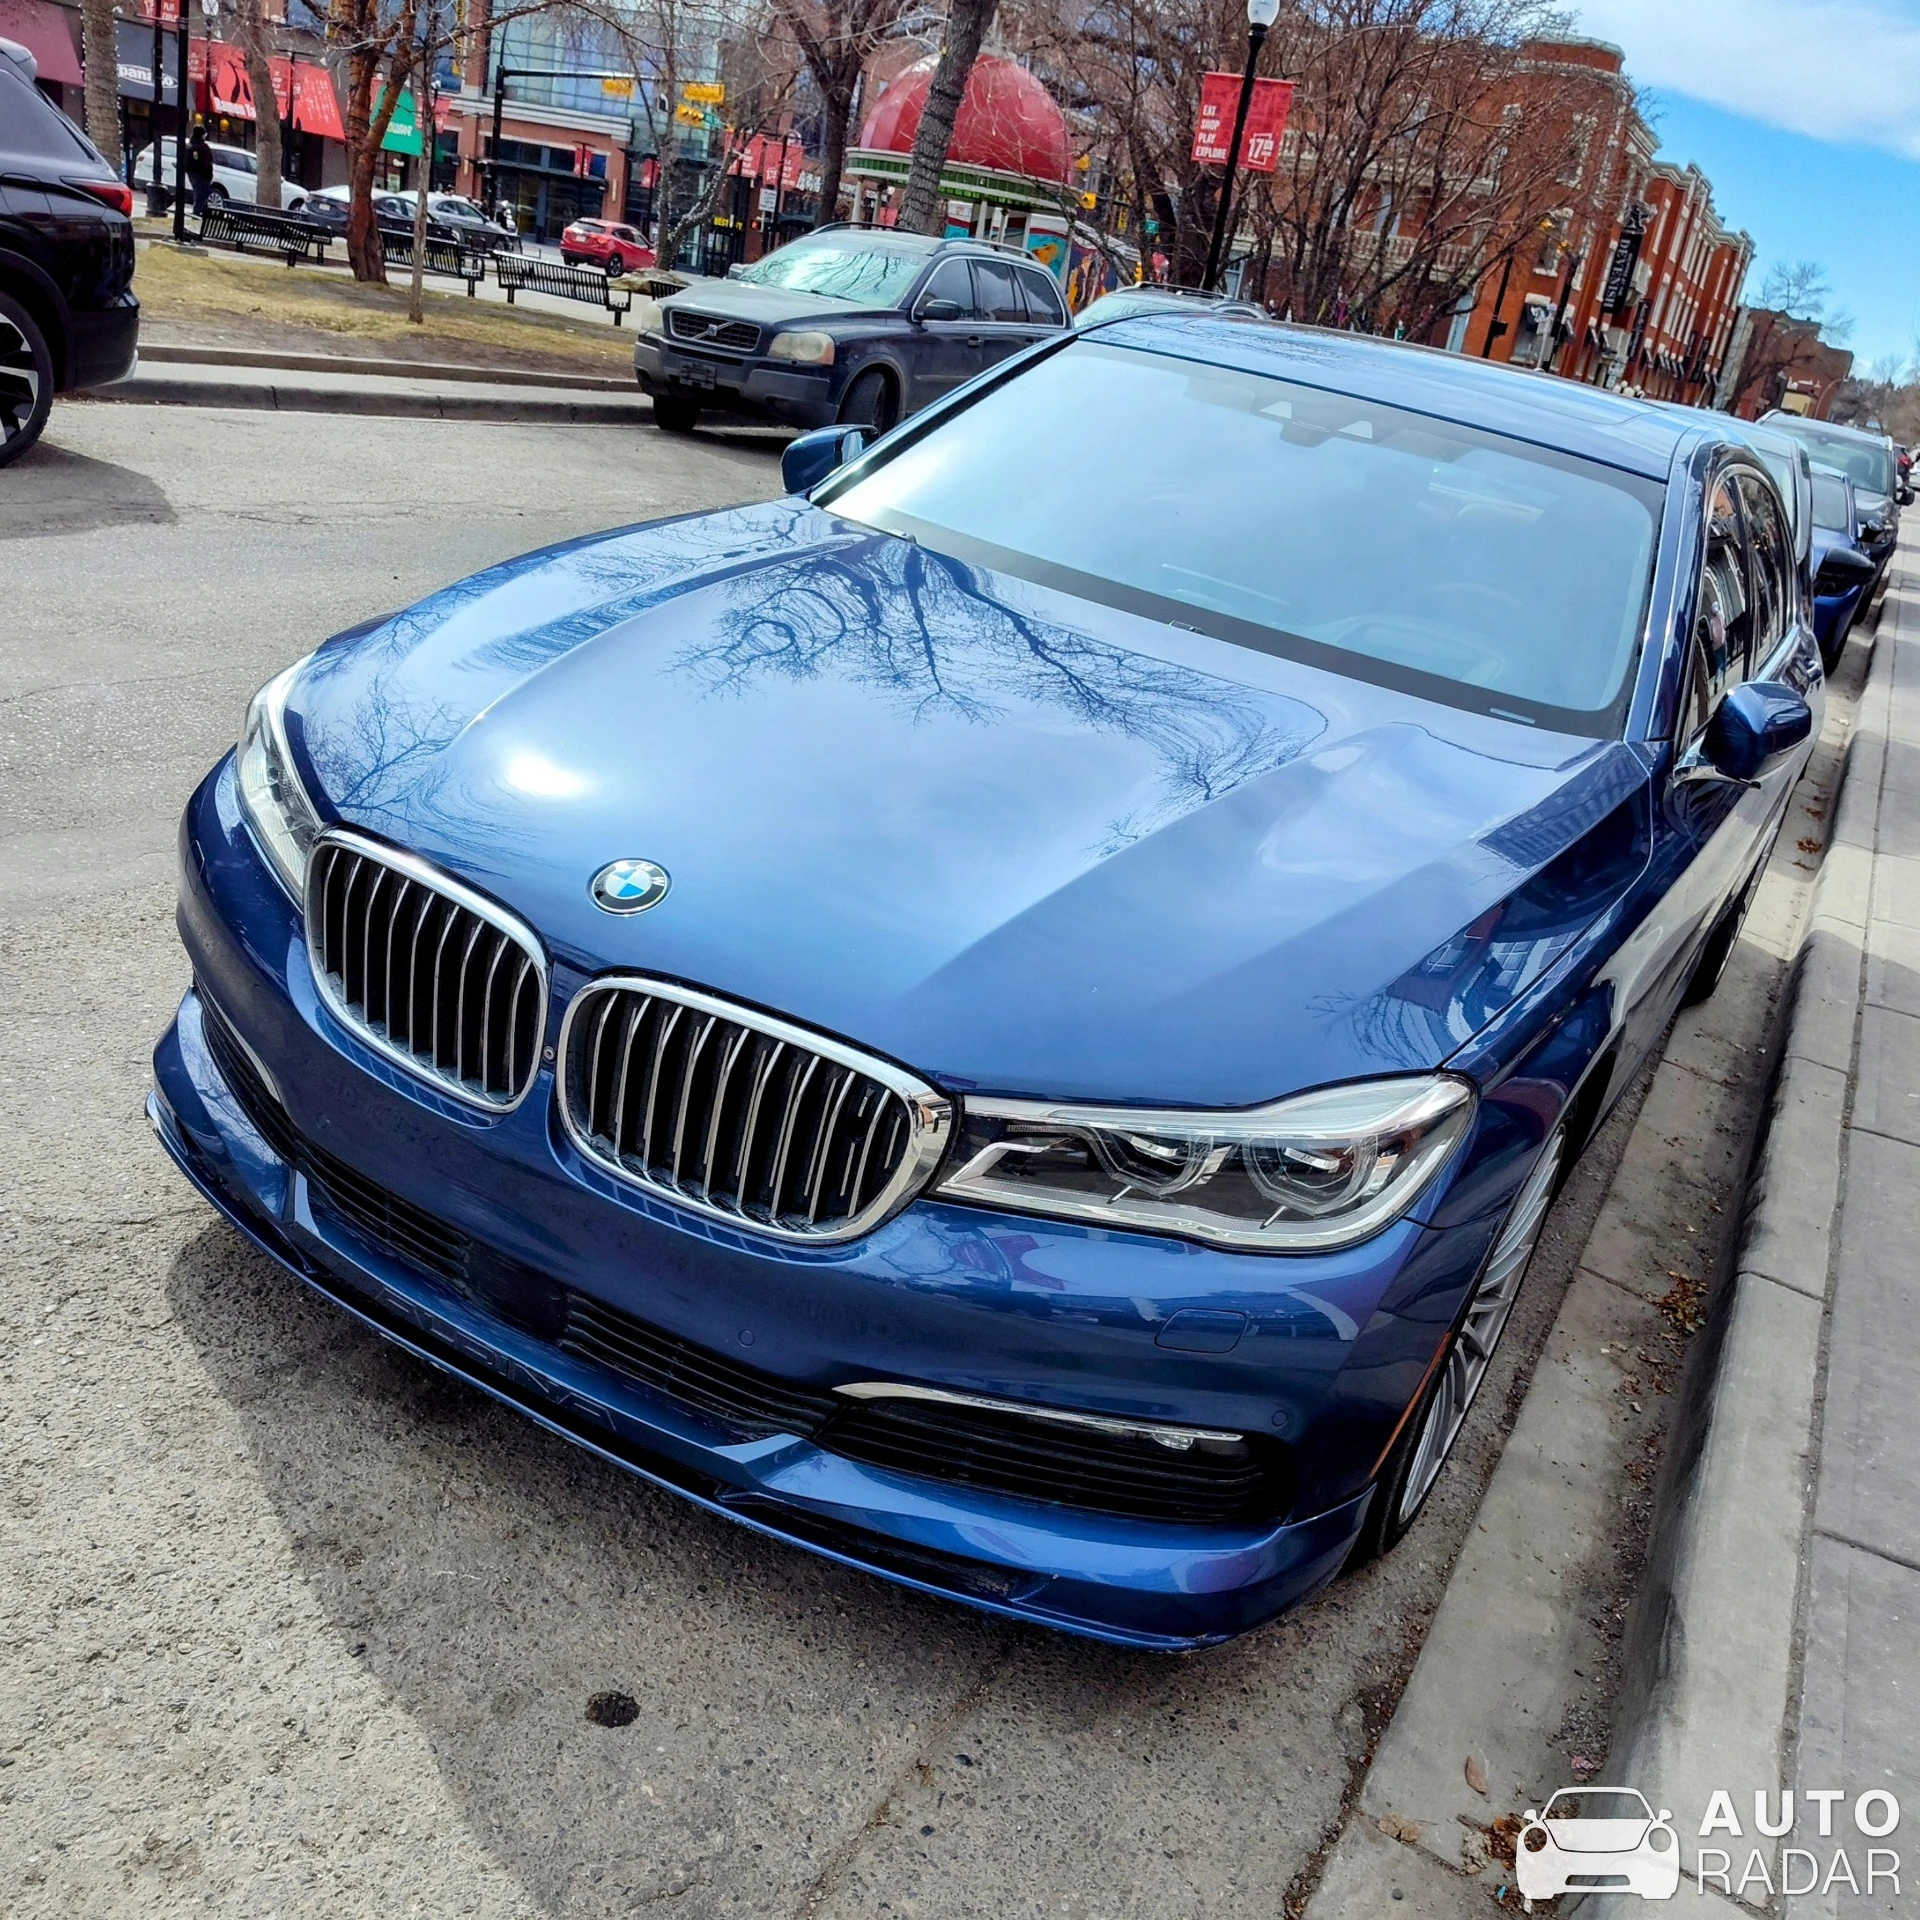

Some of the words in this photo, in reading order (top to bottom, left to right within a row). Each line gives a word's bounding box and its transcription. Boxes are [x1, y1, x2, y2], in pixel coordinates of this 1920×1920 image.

[118, 66, 174, 87] pano
[1202, 105, 1217, 116] EAT
[1200, 119, 1220, 131] SHOP
[1198, 133, 1216, 145] PLAY
[1195, 146, 1227, 160] EXPLORE
[1603, 238, 1632, 308] DEVENISH
